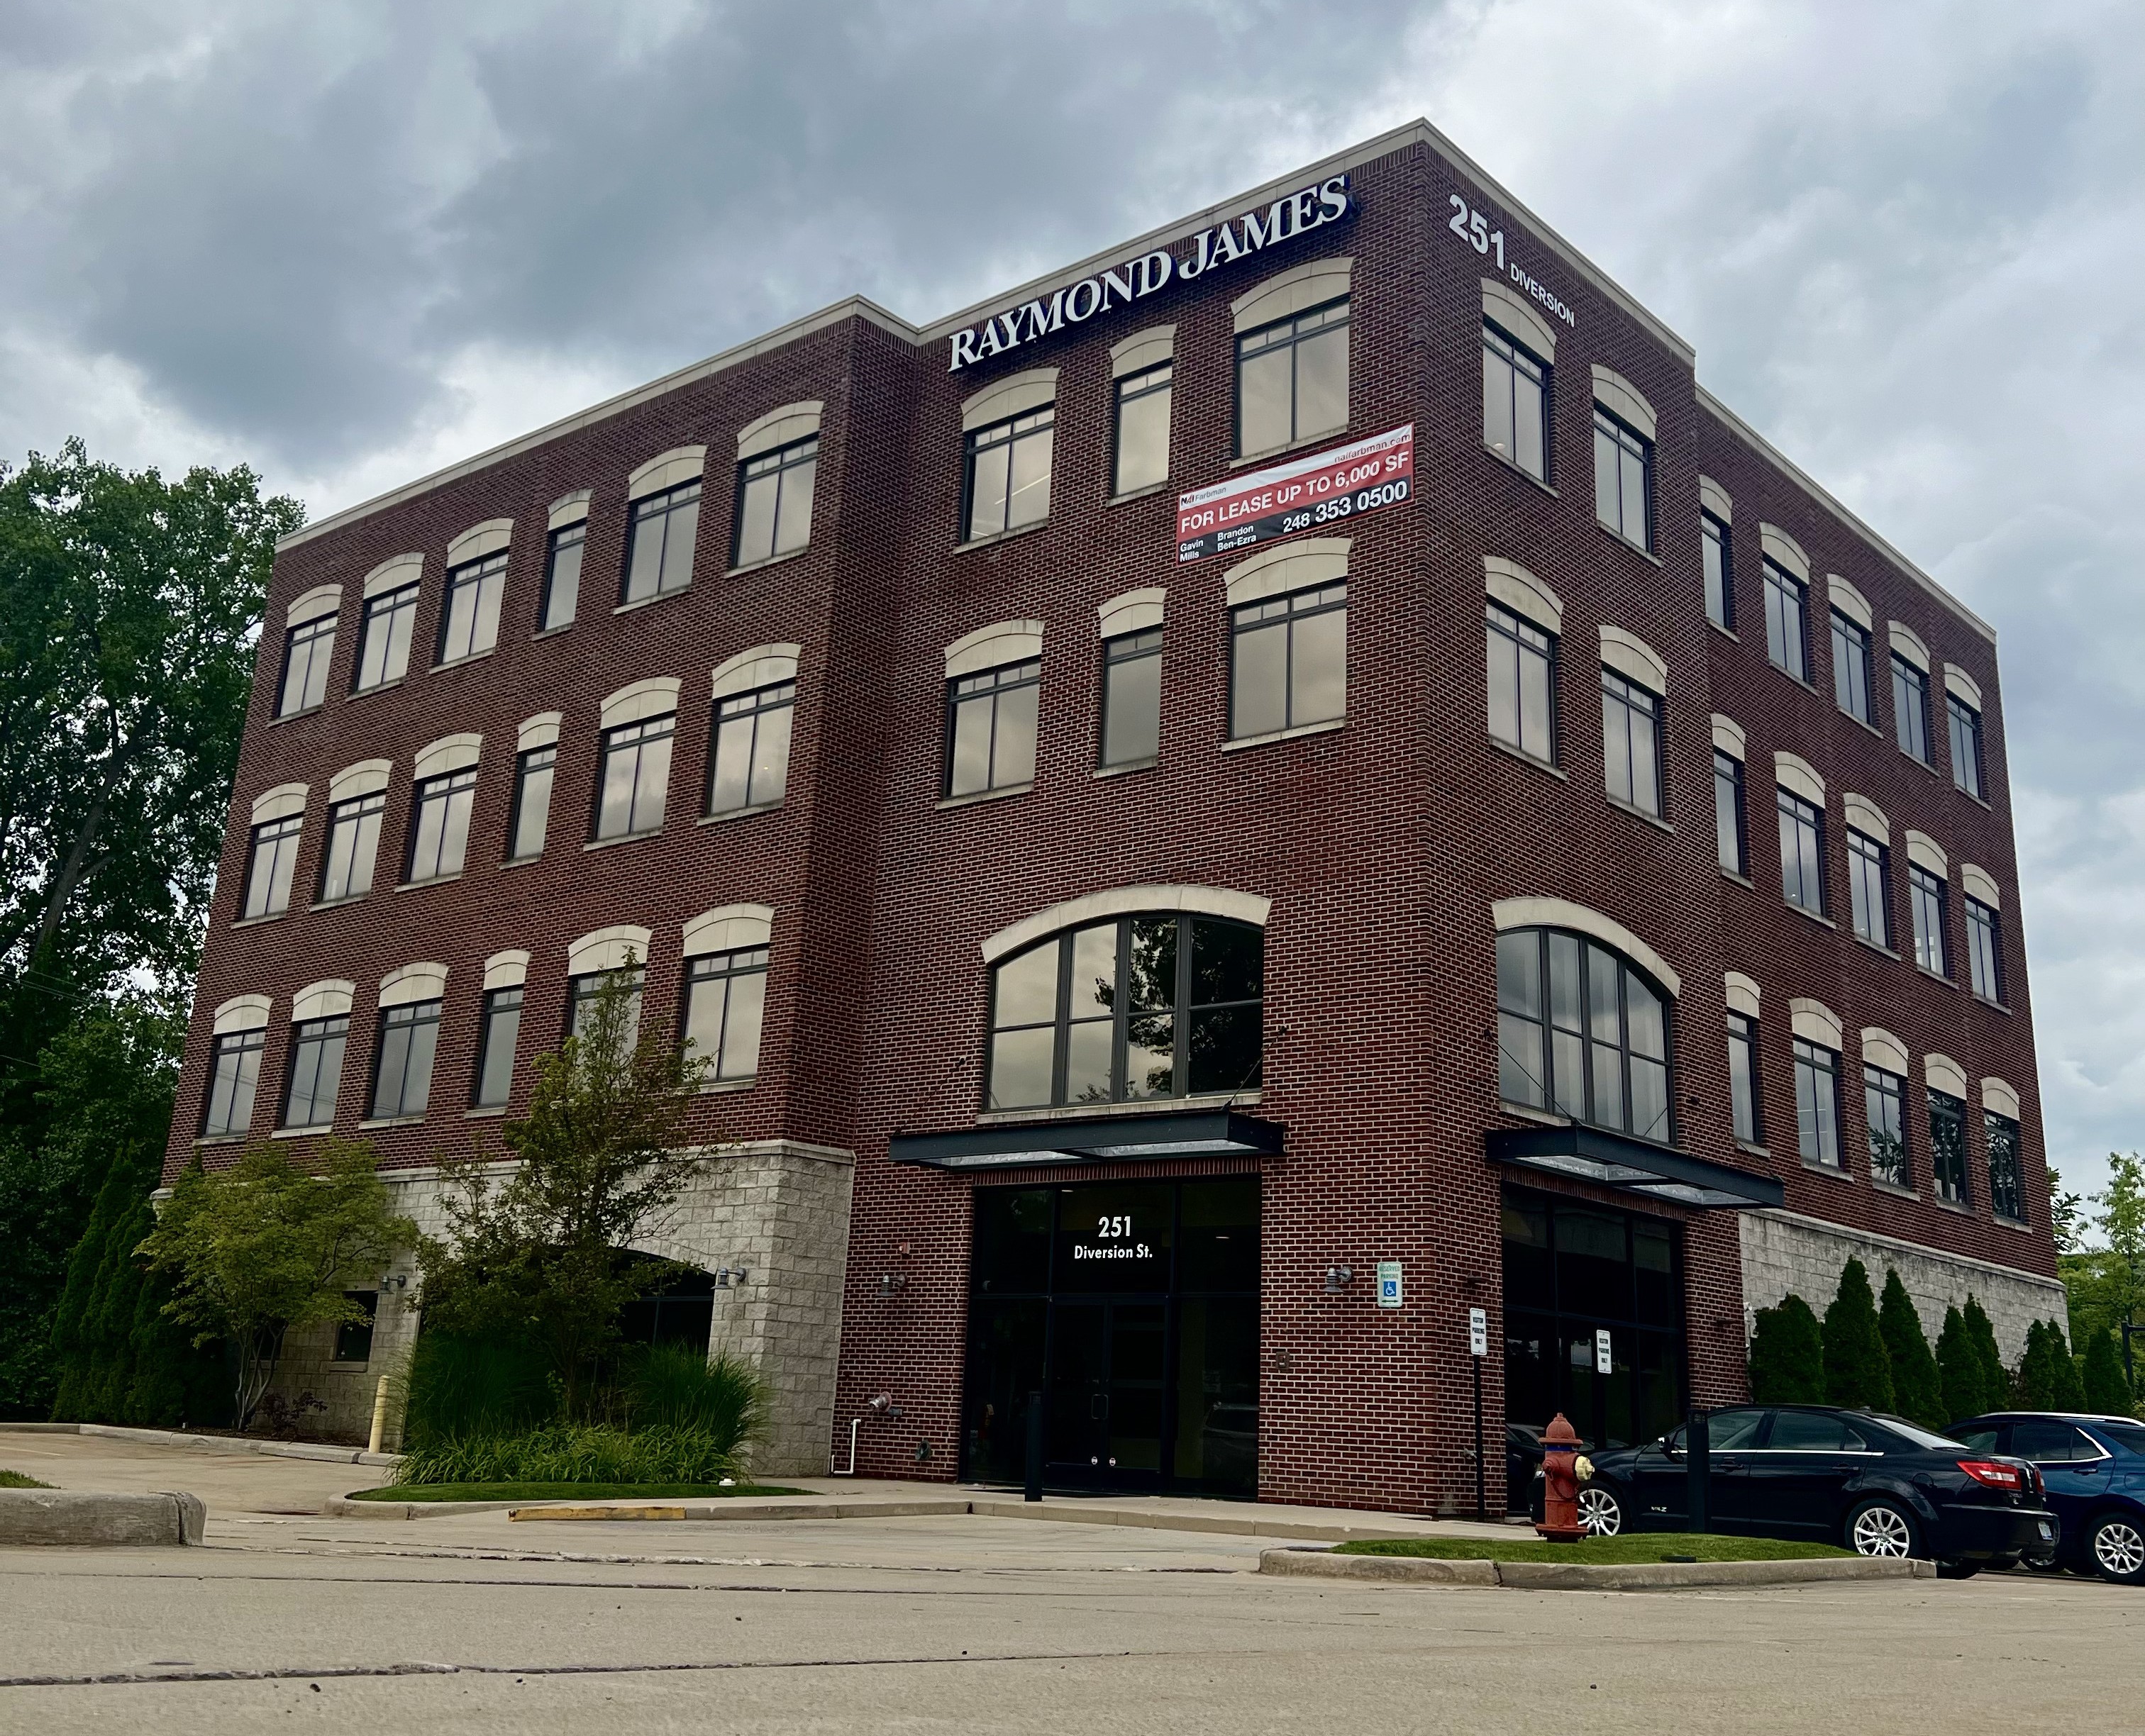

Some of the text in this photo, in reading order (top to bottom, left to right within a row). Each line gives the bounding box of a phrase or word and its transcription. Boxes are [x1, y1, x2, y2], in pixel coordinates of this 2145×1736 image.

[1448, 194, 1575, 328] 251 DIVERSION
[948, 174, 1348, 373] RAYMOND JAMES
[1334, 433, 1410, 463] naifarbman.com
[1181, 451, 1409, 533] FOR LEASE UP TO 6,000 SF
[1195, 487, 1226, 501] Farbman
[1282, 481, 1407, 533] 248 353 0500
[1217, 525, 1253, 542] Brandon
[1180, 539, 1204, 552] Gavin
[1217, 535, 1257, 552] Ben-Ezra
[1180, 551, 1199, 562] Mills
[1098, 1215, 1131, 1237] 251
[1074, 1243, 1153, 1259] Diversion St.
